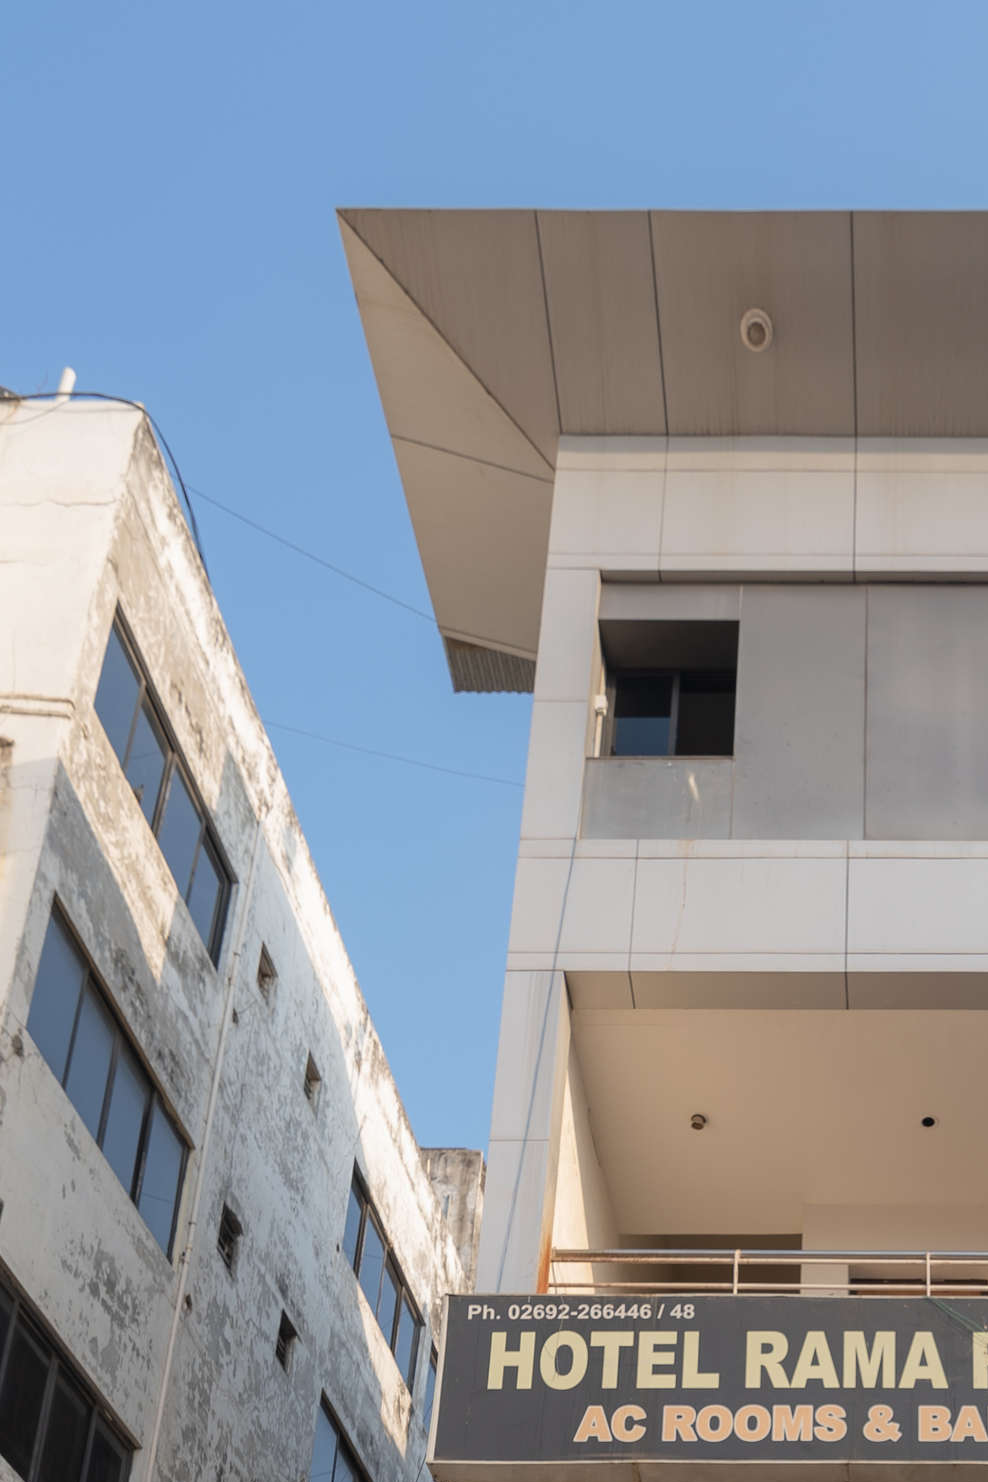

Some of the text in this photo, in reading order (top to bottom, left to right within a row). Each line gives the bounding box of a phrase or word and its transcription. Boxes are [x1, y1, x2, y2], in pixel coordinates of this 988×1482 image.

[468, 1304, 695, 1320] Ph. 02692-266446 / 48
[487, 1330, 720, 1391] HOTEL
[745, 1330, 949, 1390] RAMA
[573, 1404, 647, 1443] AC
[661, 1404, 847, 1443] ROOMS
[862, 1405, 902, 1443] &
